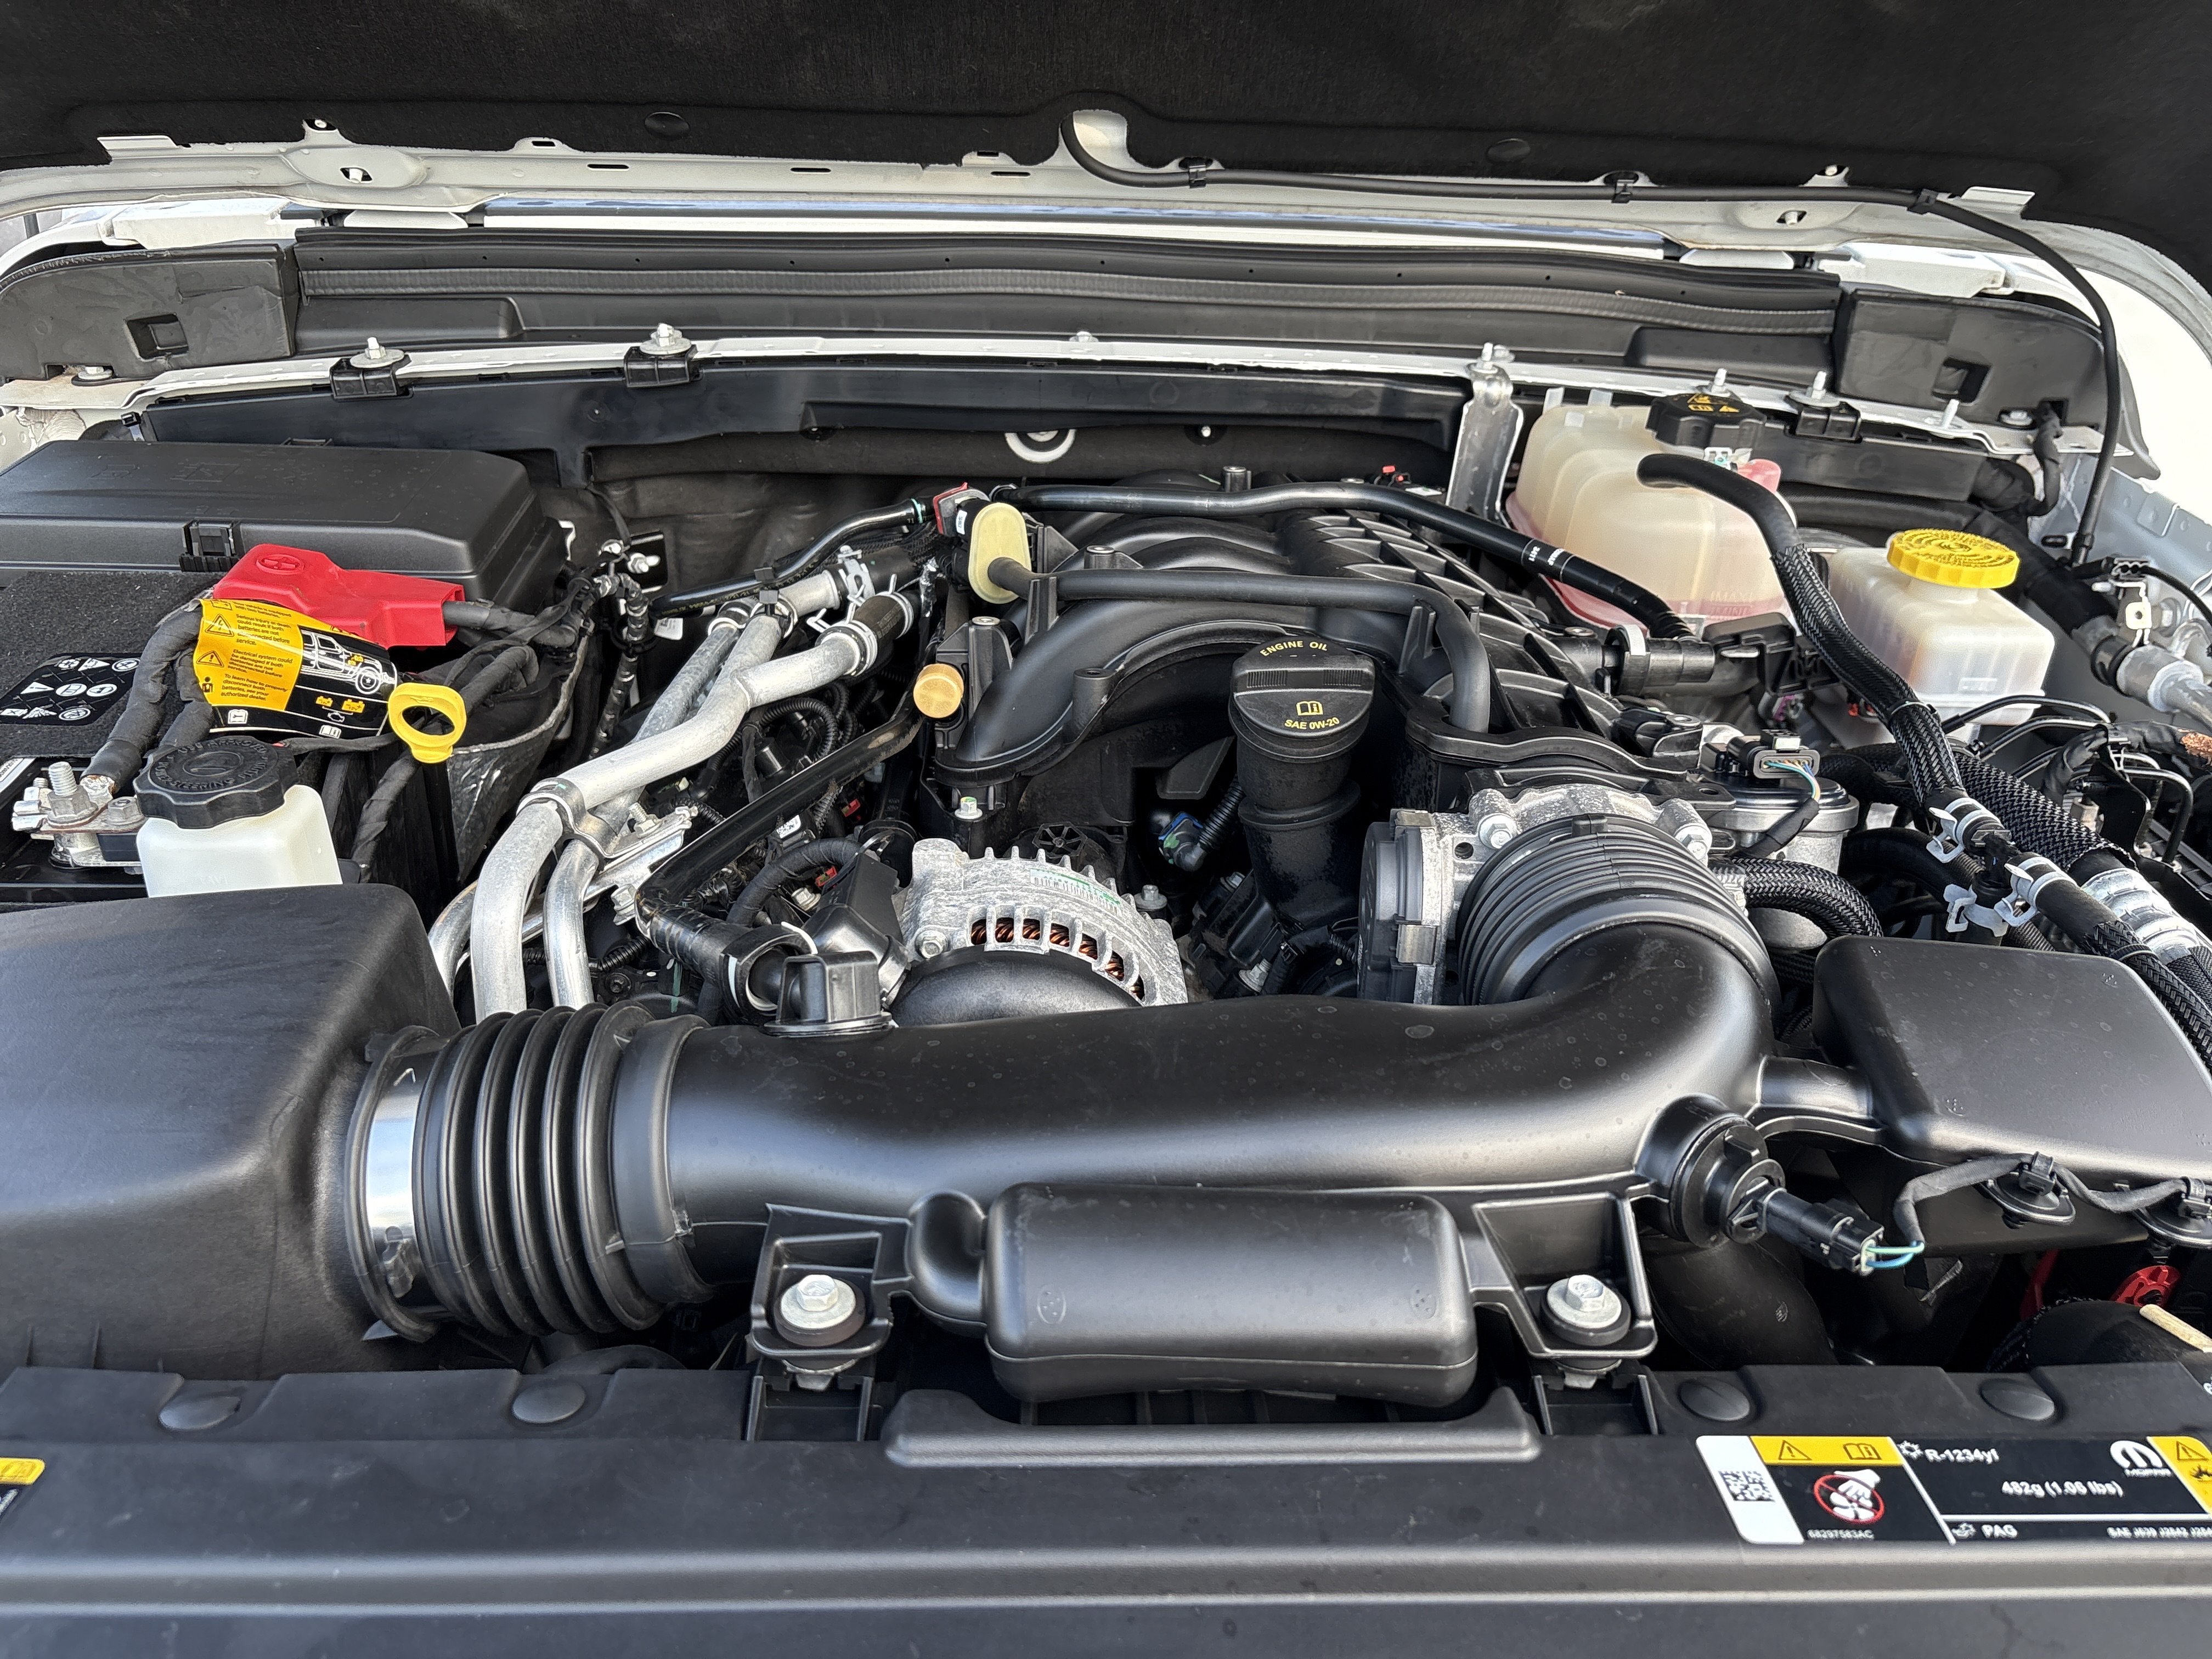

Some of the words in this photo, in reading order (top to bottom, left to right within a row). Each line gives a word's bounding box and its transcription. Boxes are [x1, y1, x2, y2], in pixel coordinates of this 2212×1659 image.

[238, 624, 261, 633] batteries
[236, 637, 257, 646] service.
[273, 635, 290, 644] before
[1260, 640, 1304, 657] ENGINE
[1309, 641, 1328, 651] OIL
[233, 649, 258, 658] Electrical
[258, 653, 277, 662] system
[240, 656, 265, 664] damaged
[230, 657, 253, 666] batteries
[227, 665, 247, 674] service.
[228, 661, 264, 674] disconnected
[222, 679, 252, 688] disconnect
[265, 684, 289, 693] properly
[1284, 719, 1307, 730] SAE
[1309, 716, 1340, 730] 0W-20
[1924, 1448, 1999, 1464] R-1234yf
[2001, 1481, 2045, 1498] 482g
[2086, 1481, 2124, 1498] lbs)
[1982, 1524, 2018, 1537] PAG
[2107, 1527, 2132, 1538] SAE
